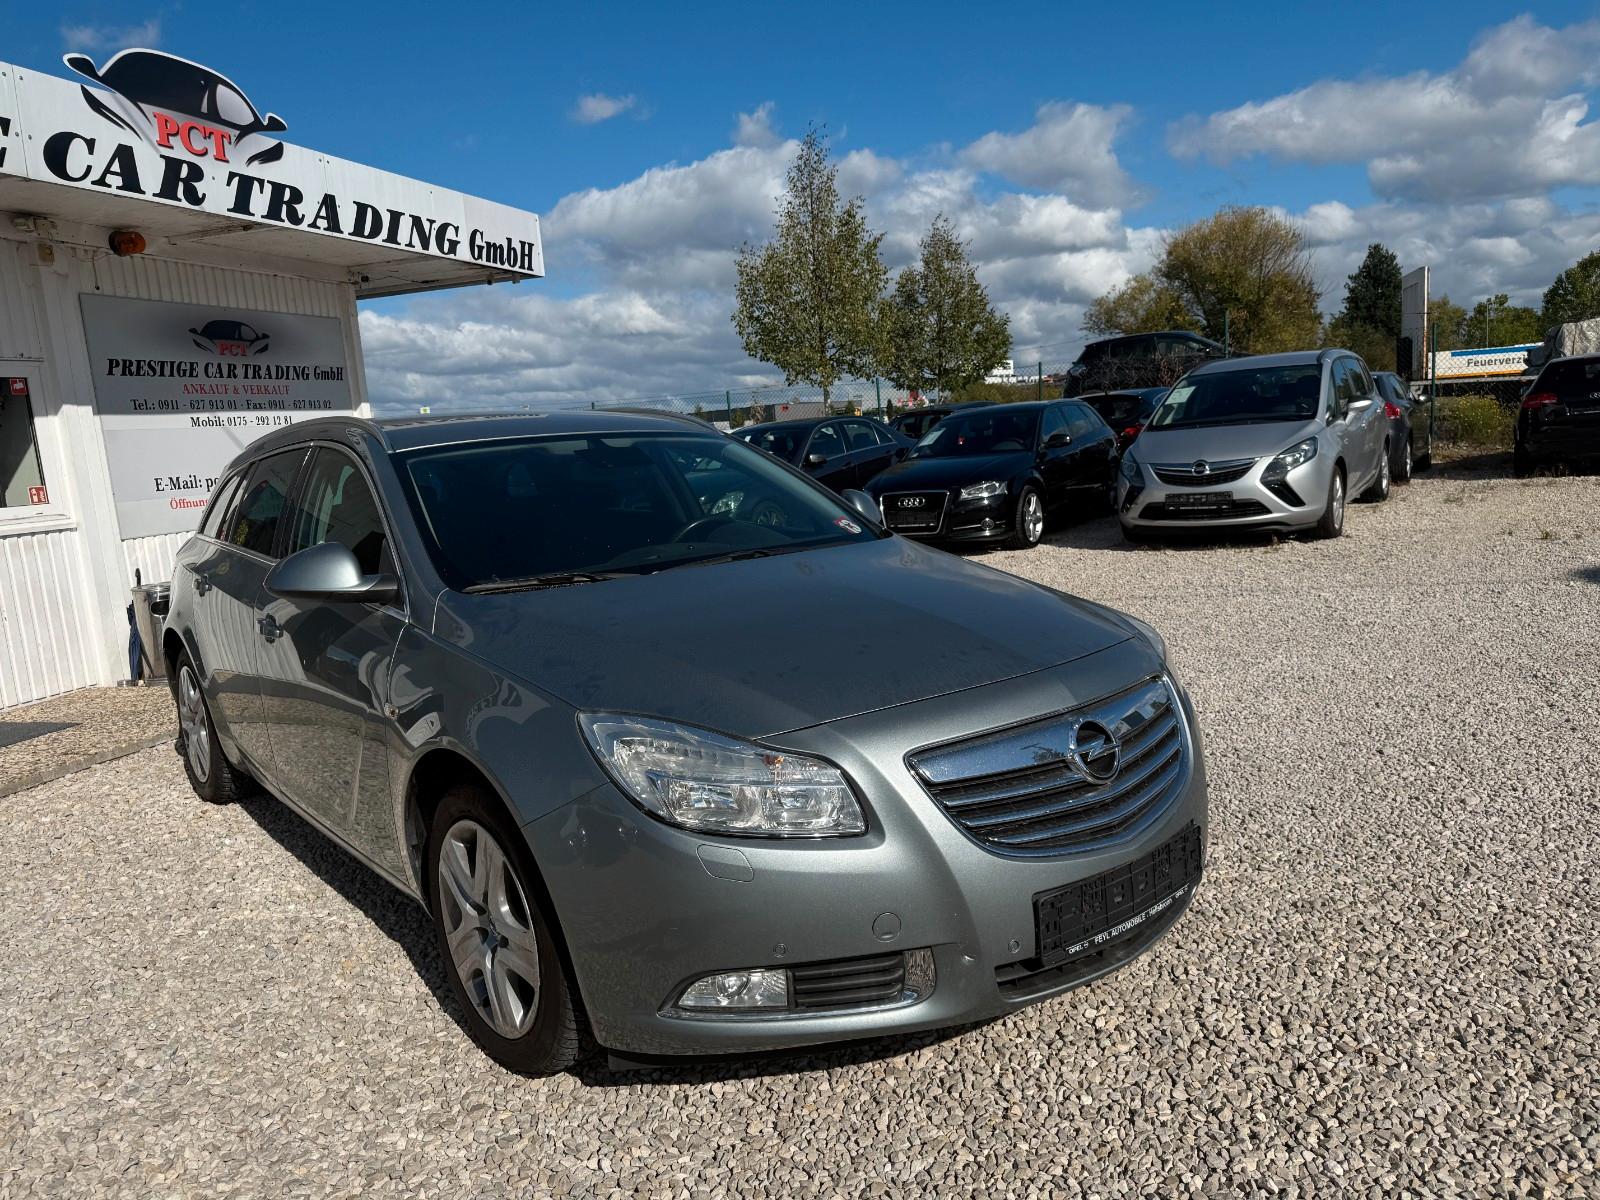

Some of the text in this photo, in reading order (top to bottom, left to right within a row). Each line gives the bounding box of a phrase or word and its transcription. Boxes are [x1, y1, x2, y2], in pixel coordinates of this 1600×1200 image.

[153, 111, 233, 163] PCT
[42, 130, 207, 206] CAR
[226, 170, 462, 257] TRADING
[468, 228, 535, 272] GmbH
[218, 341, 248, 357] PCT
[106, 358, 344, 381] PRESTIGE CAR TRADING GmbH
[182, 383, 290, 395] ANKAUF & VERKAUF
[130, 399, 156, 411] Tel.:
[158, 399, 180, 410] 0911
[190, 399, 205, 410] 627
[209, 399, 225, 410] 913
[227, 399, 238, 410] 01
[246, 399, 267, 410] Fax:
[268, 399, 285, 409] 0911
[293, 399, 307, 409] 627
[308, 399, 321, 409] 913
[190, 415, 225, 428] Mobil:
[227, 416, 248, 427] 0175
[255, 415, 270, 426] 292
[273, 415, 282, 426] 12
[284, 415, 294, 426] 81
[154, 474, 203, 492] E-Mail:
[1094, 932, 1110, 945] FEYL
[1111, 912, 1147, 938] AUTOMOBILE
